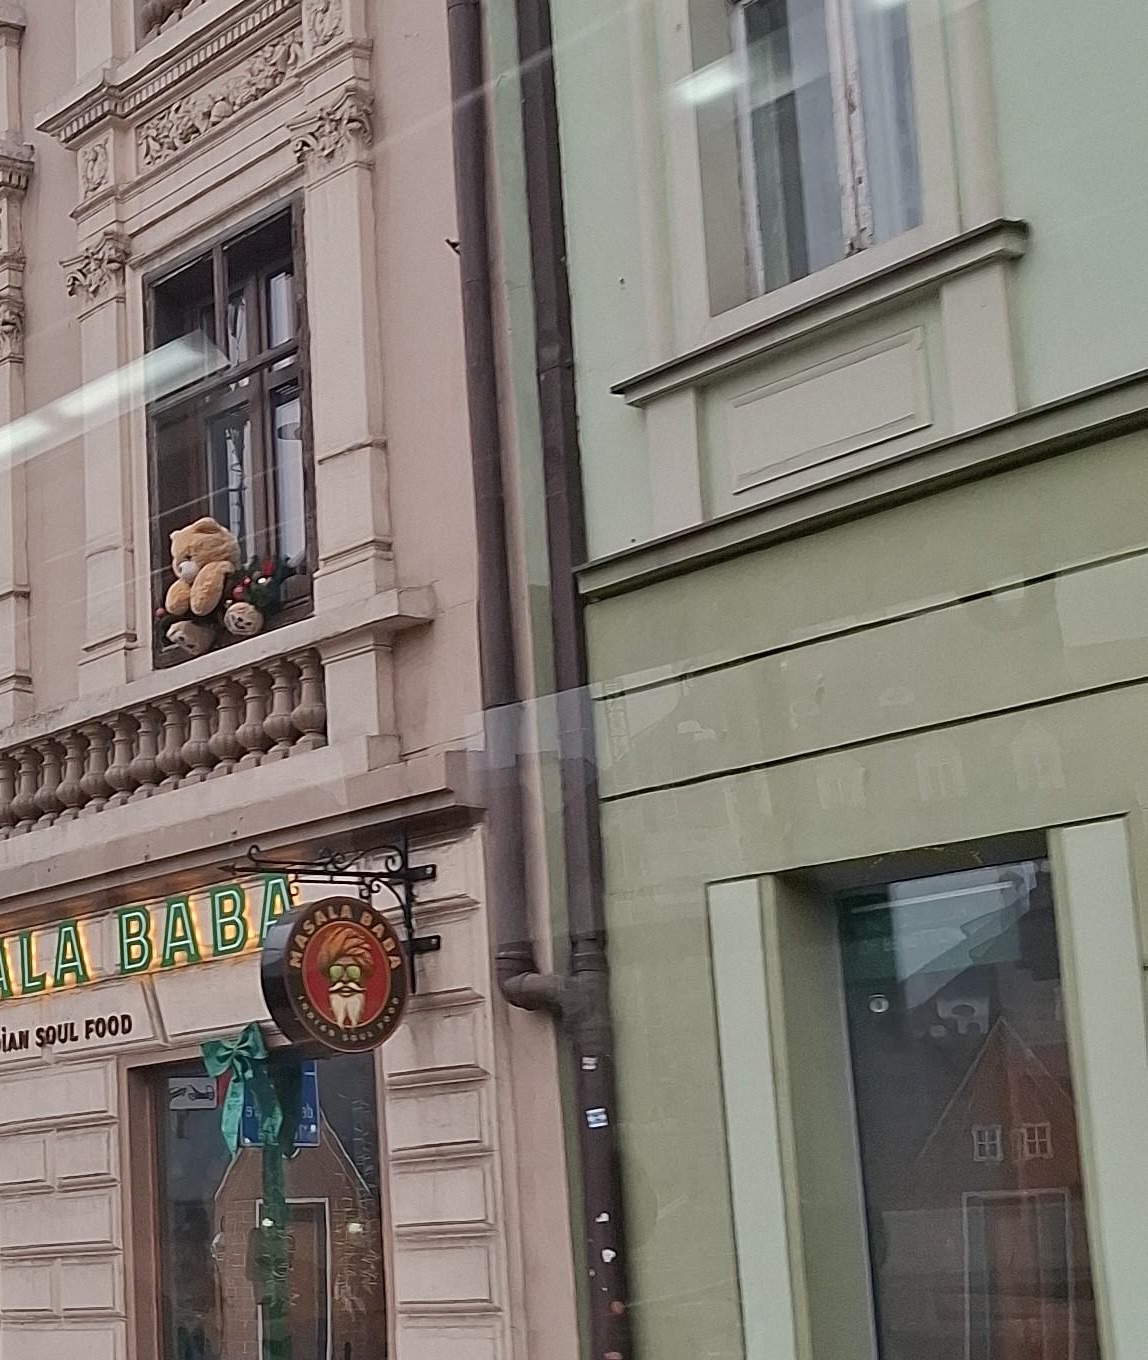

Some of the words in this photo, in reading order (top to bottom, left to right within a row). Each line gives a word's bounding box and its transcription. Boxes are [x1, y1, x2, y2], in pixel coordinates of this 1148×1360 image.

[117, 873, 293, 975] BABA
[289, 904, 353, 969] MASALA
[360, 910, 402, 970] BABA
[35, 1021, 79, 1048] SOUL
[84, 1014, 133, 1041] FOOD
